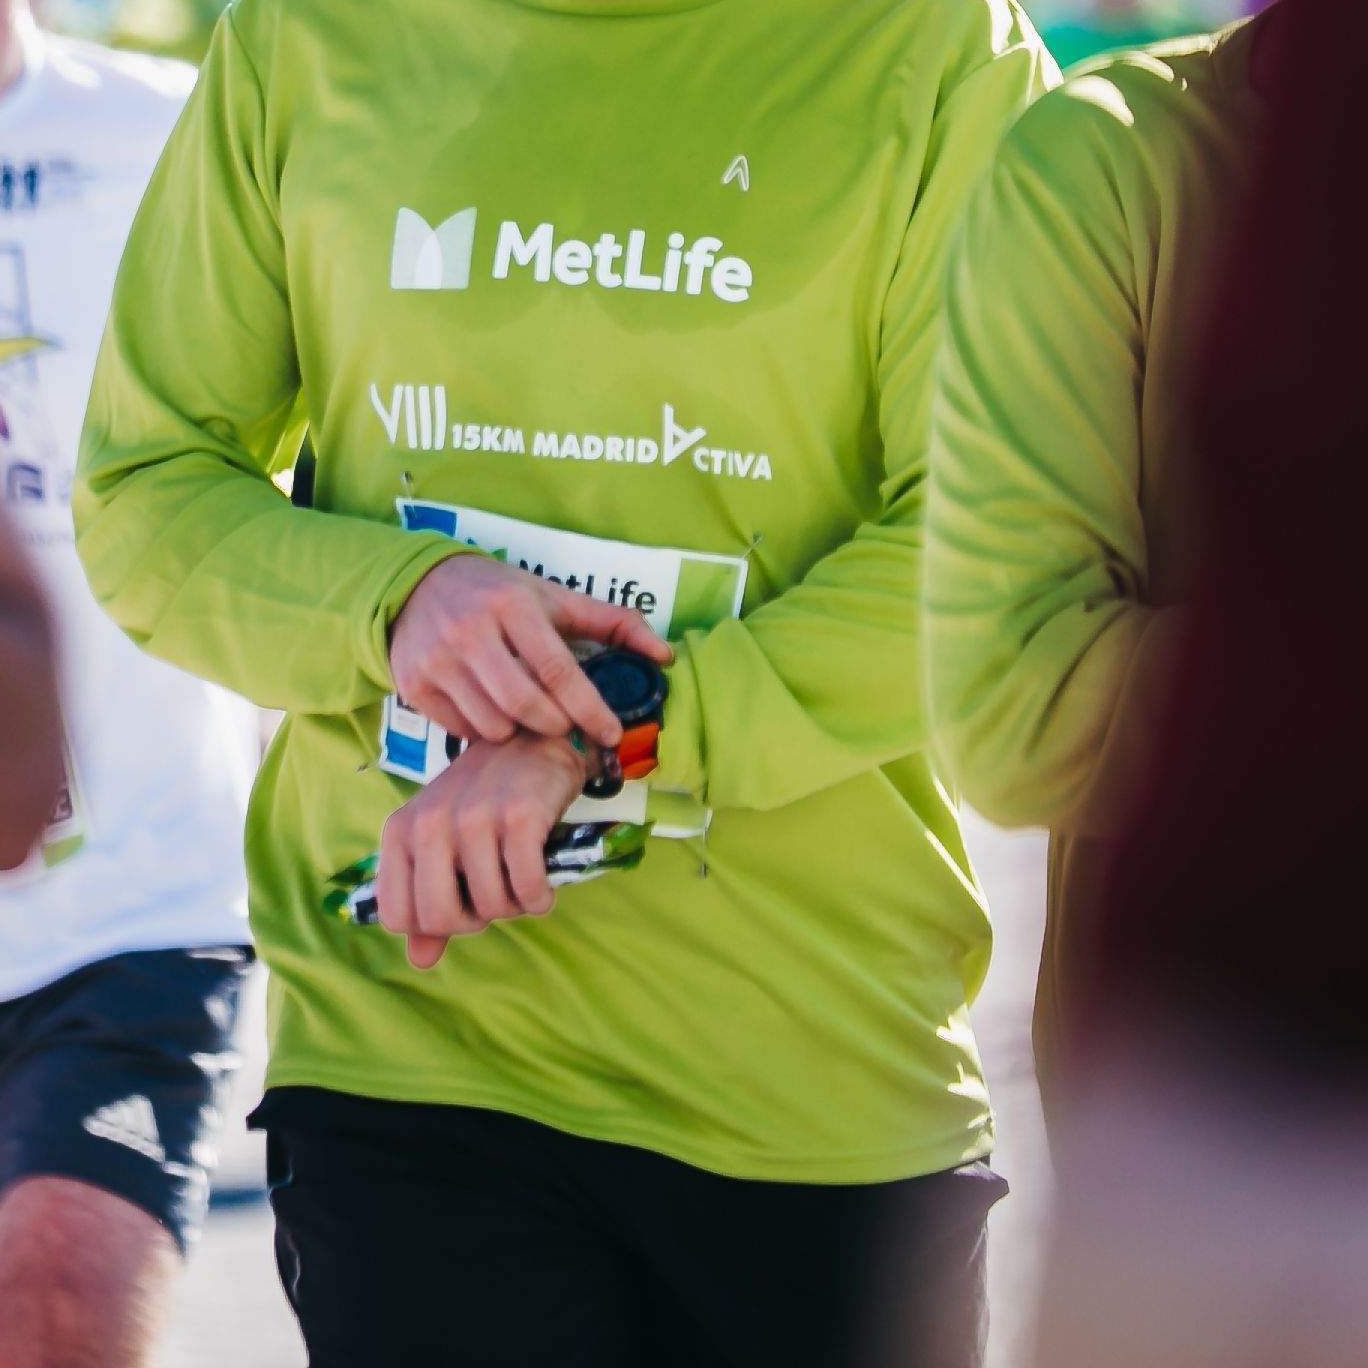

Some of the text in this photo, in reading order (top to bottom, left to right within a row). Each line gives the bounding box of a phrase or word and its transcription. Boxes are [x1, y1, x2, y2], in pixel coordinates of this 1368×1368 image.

[493, 221, 753, 302] MetLife
[370, 384, 447, 450] VIII
[452, 423, 525, 455] 15KM
[532, 432, 659, 464] MADRID
